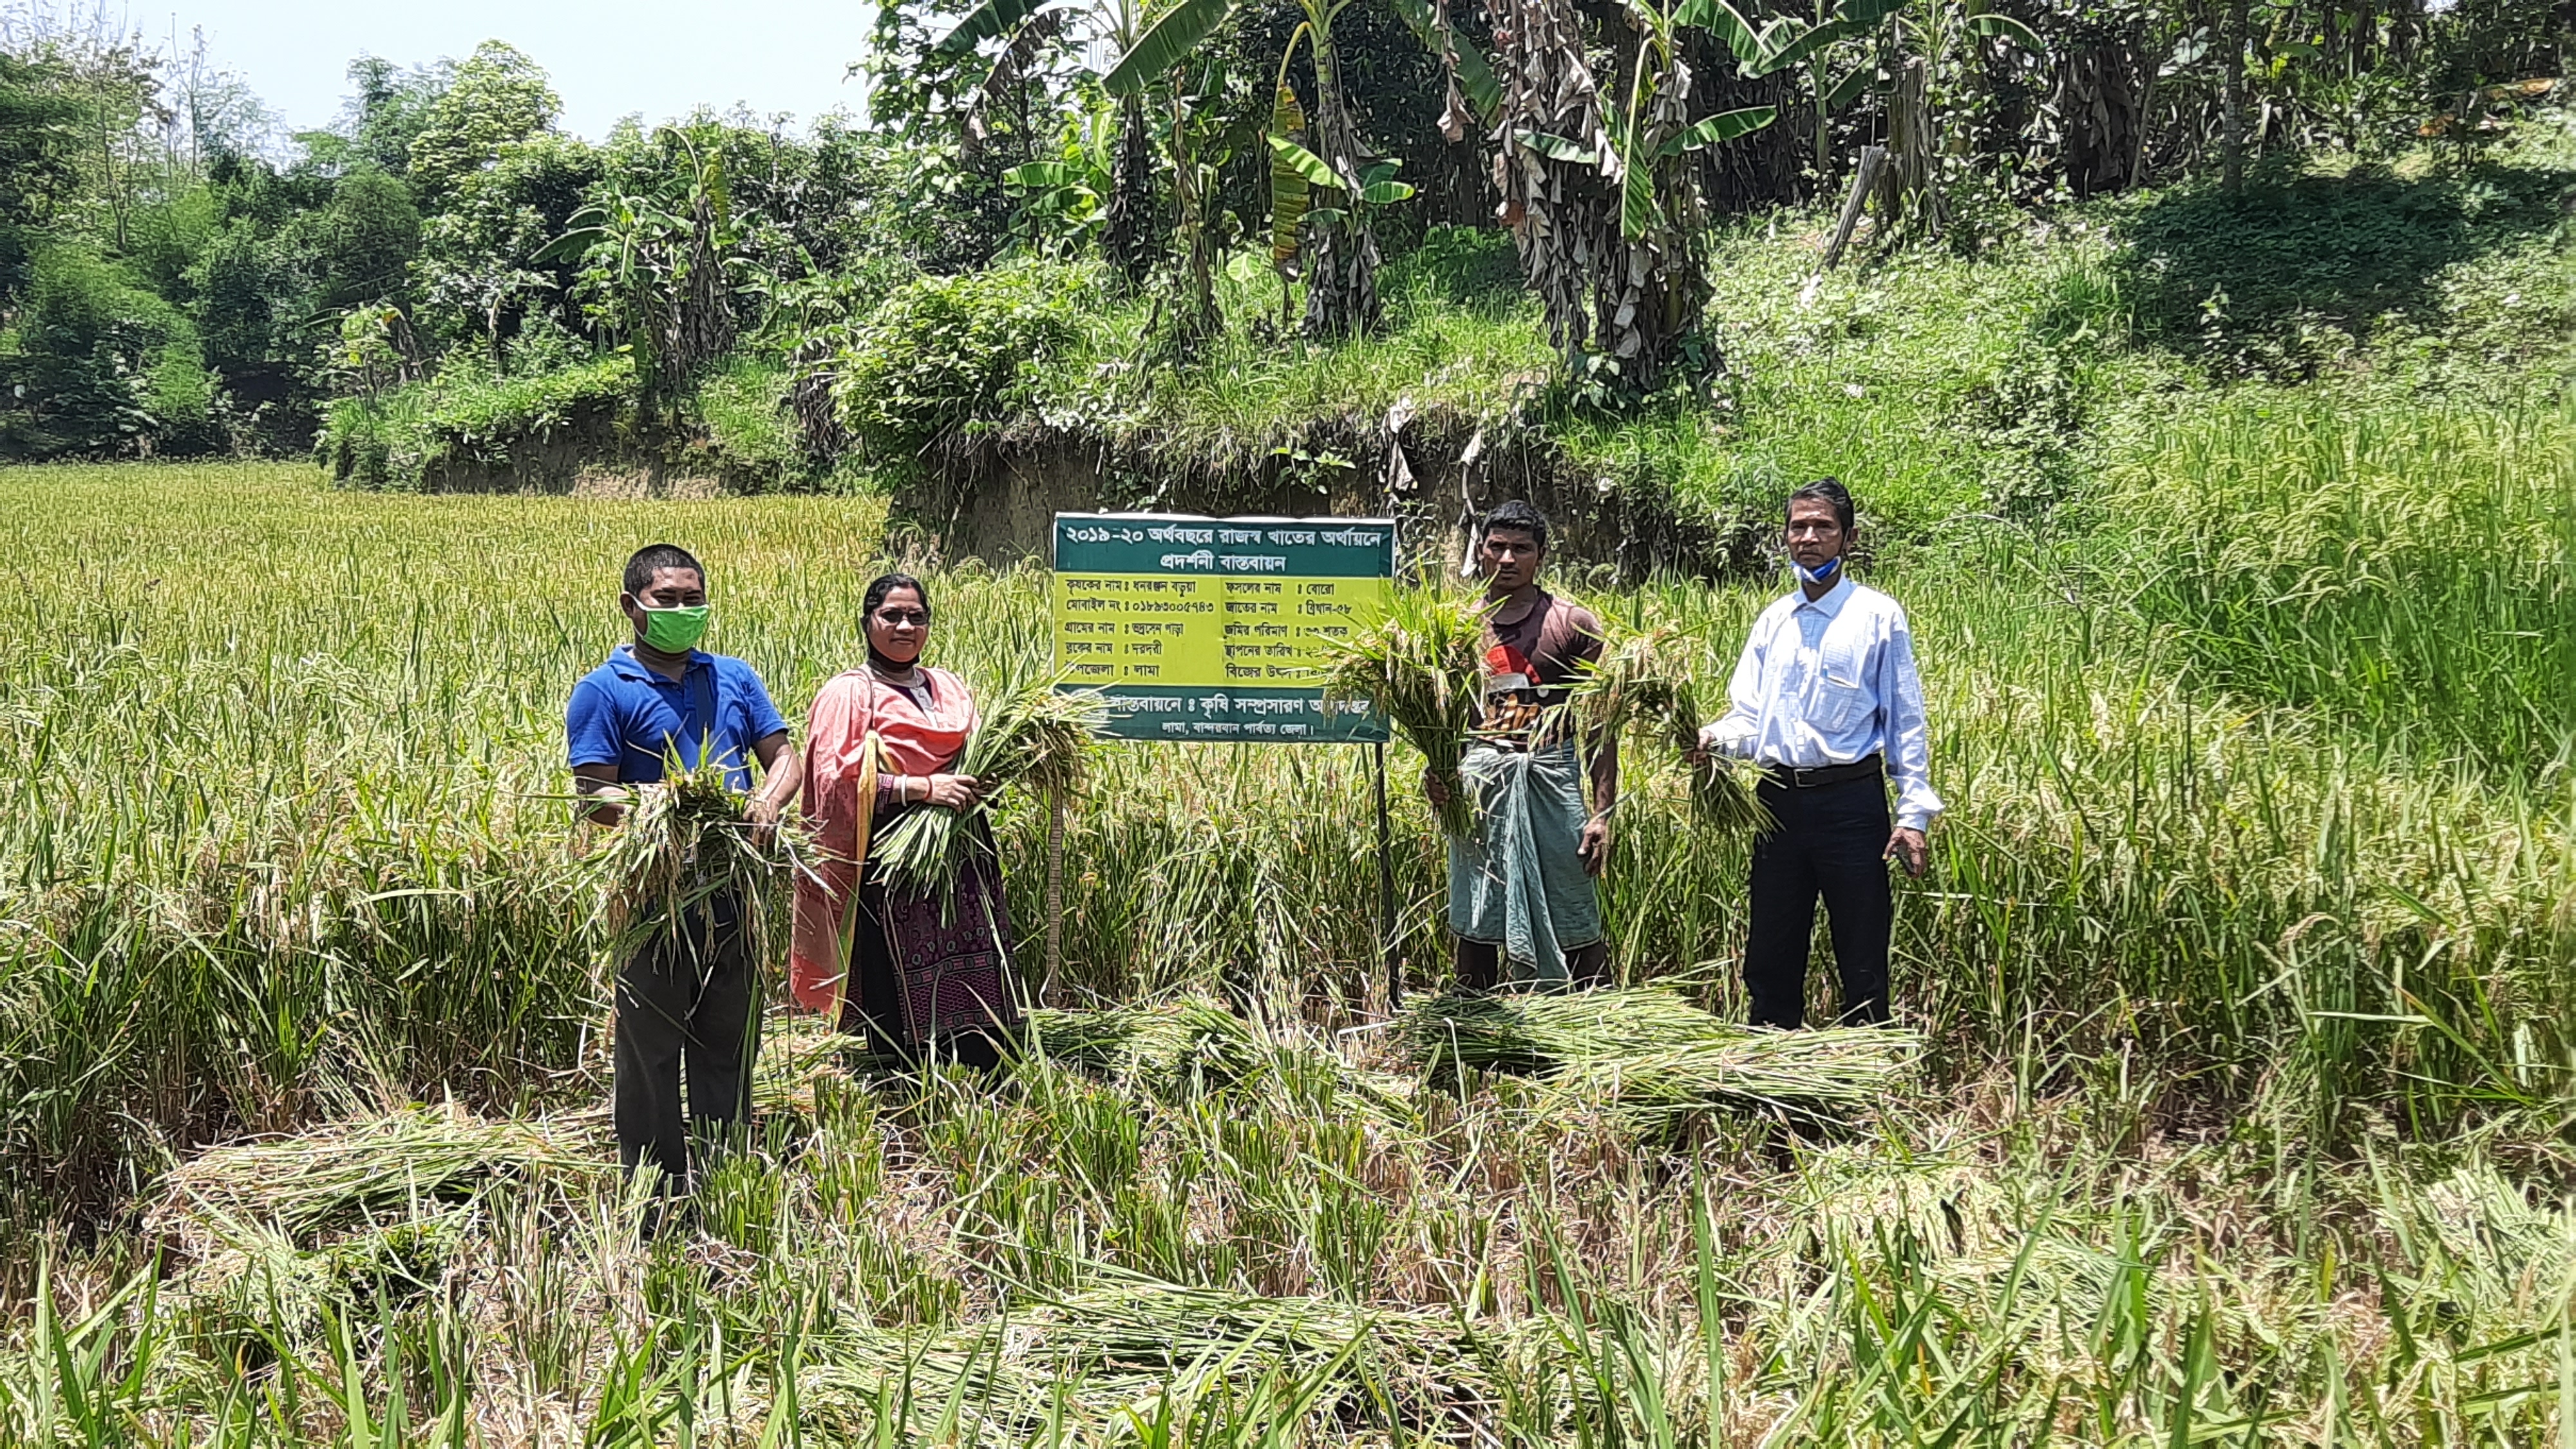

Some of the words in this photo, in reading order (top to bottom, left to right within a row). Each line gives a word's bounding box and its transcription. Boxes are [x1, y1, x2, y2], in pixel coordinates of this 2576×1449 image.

[1066, 527, 1143, 545] ২০১৯-২০
[1147, 524, 1213, 545] অর্থবছরে
[1218, 528, 1262, 545] রাজস্ব
[1267, 529, 1316, 546] খাতের
[1320, 527, 1382, 547] অর্থায়নে
[1160, 550, 1213, 570] প্রদর্শনী
[1218, 554, 1287, 572] বাস্তবায়ন
[1065, 579, 1101, 595] কৃষকের
[1104, 580, 1122, 592] নাম
[1226, 582, 1260, 594] ফসলের
[1264, 582, 1282, 594] নাম
[1306, 583, 1334, 595] বোরো
[1066, 597, 1105, 612] মোবাইল
[1108, 600, 1122, 612] নং
[1225, 601, 1256, 614] জাতের
[1260, 602, 1278, 614] নাম
[1065, 621, 1094, 634] গ্রামের
[1097, 622, 1115, 634] নাম
[1224, 622, 1250, 638] জমির
[1255, 622, 1288, 637] পরিমাণ
[1094, 643, 1113, 654] নাম
[1264, 643, 1293, 658] তারিখ
[1134, 664, 1160, 677] লামা
[1199, 694, 1229, 719] কৃষি
[1233, 697, 1303, 716] সম্প্রসারণ
[1244, 719, 1276, 735] পার্বত্য
